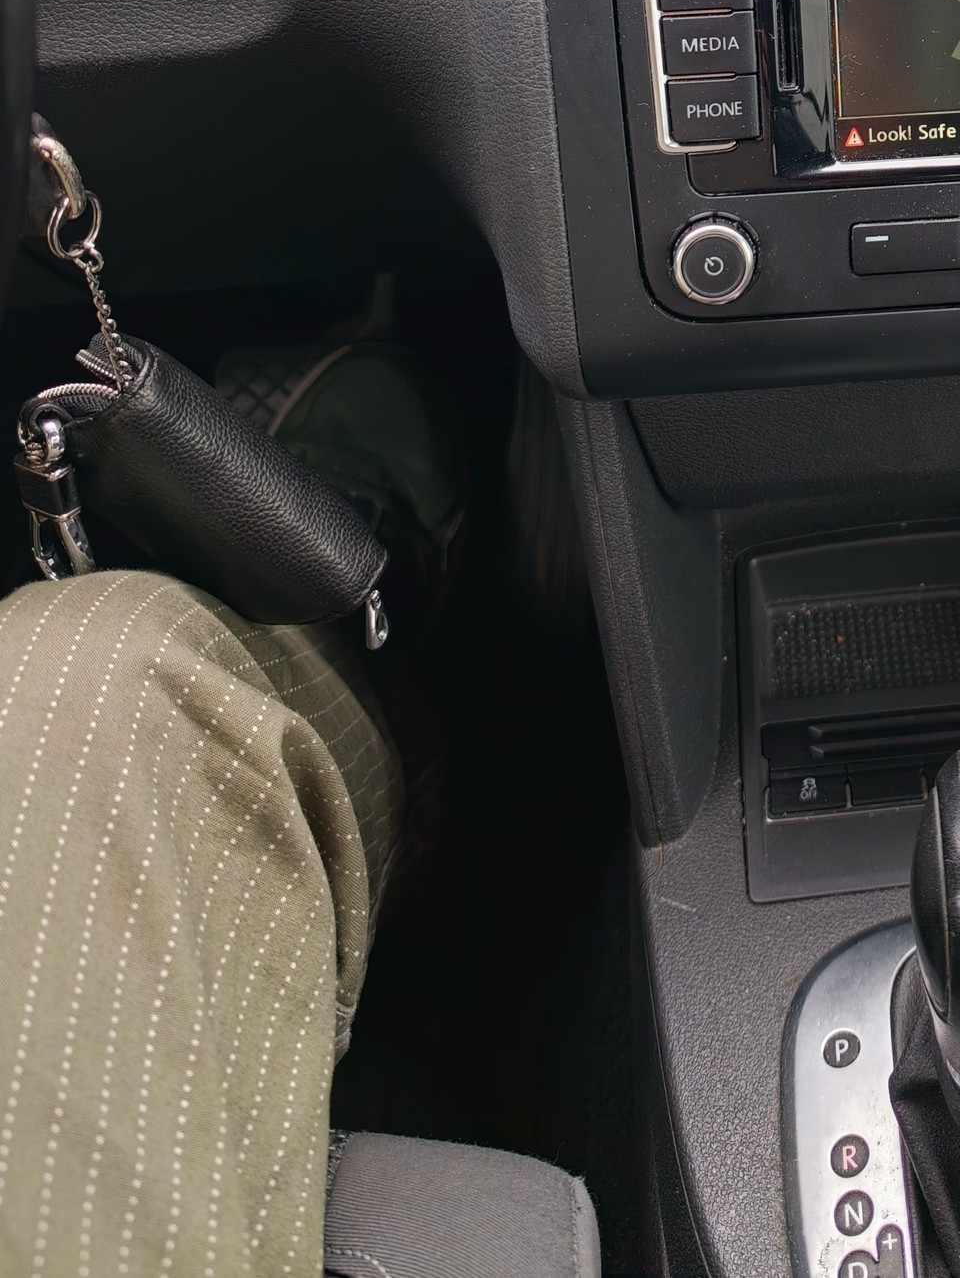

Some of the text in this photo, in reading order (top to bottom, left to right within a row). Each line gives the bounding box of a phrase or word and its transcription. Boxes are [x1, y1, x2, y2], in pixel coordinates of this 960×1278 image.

[681, 37, 740, 53] MEDIA
[686, 101, 743, 119] PHONE
[868, 126, 912, 143] Look!
[918, 124, 957, 140] Safe
[835, 1039, 848, 1062] P
[842, 1145, 858, 1170] R
[844, 1201, 864, 1228] N
[848, 1261, 869, 1278] D
